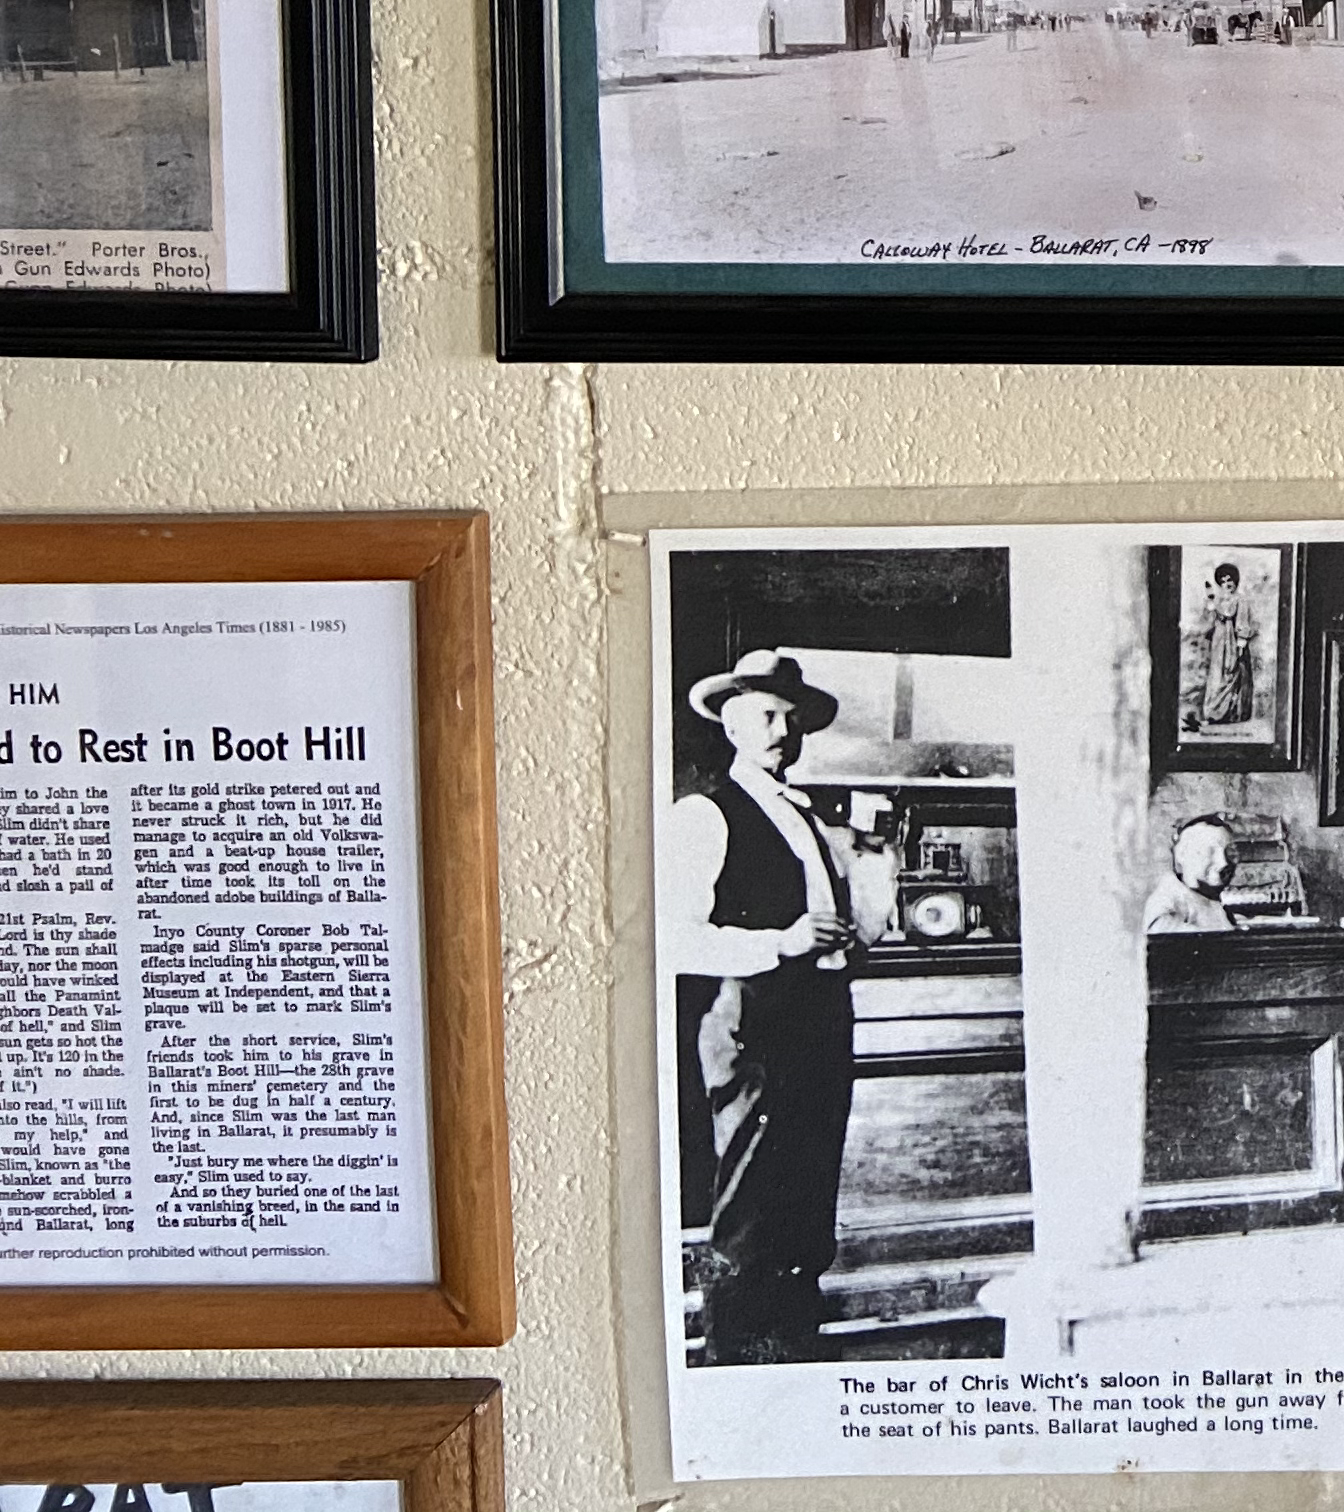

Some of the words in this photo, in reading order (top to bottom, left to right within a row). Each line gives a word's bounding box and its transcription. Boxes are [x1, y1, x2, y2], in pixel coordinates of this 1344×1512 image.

[91, 241, 145, 258] Porter
[14, 260, 51, 277] Gun
[64, 260, 141, 277] Edwards
[153, 261, 210, 279] Photo)
[53, 622, 131, 638] Newspapers
[133, 621, 158, 634] Los
[160, 620, 213, 637] Angeles
[214, 620, 256, 633] Times
[309, 619, 346, 634] 1985)
[8, 681, 60, 705] HIM
[29, 733, 62, 763] to
[77, 727, 149, 763] Rest
[162, 727, 194, 762] in
[211, 726, 289, 761] Boot
[304, 725, 365, 761] Hill
[130, 783, 163, 796] after
[168, 782, 186, 796] its
[190, 781, 220, 798] gold
[225, 782, 265, 795] strike
[269, 781, 322, 797] petered
[326, 782, 350, 795] out
[354, 782, 381, 795] and
[152, 924, 185, 939] Inyo
[195, 922, 245, 939] County
[255, 923, 311, 936] Coroner
[321, 922, 349, 936] Bob
[359, 922, 388, 936] Tal-
[59, 1018, 85, 1032] and
[90, 1018, 122, 1032] Slim
[38, 1246, 123, 1261] reproduction
[124, 1245, 195, 1261] prohibited
[197, 1244, 247, 1257] without
[250, 1244, 330, 1259] permission.
[838, 1377, 875, 1393] The
[886, 1377, 916, 1393] bar
[928, 1375, 947, 1392] of
[960, 1374, 1008, 1391] Chris
[1019, 1372, 1088, 1389] Wicht's
[1099, 1371, 1159, 1388] saloon
[1172, 1370, 1189, 1386] in
[1202, 1368, 1273, 1388] Ballarat
[1285, 1368, 1302, 1384] in
[1314, 1367, 1344, 1383] the
[840, 1404, 849, 1415] a
[859, 1401, 944, 1415] customer
[954, 1400, 974, 1416] to
[985, 1396, 1036, 1413] leave.
[1046, 1395, 1082, 1412] The
[1092, 1398, 1131, 1411] man
[1141, 1393, 1185, 1410] took
[1195, 1392, 1225, 1409] the
[1235, 1395, 1268, 1412] gun
[1278, 1394, 1325, 1410] away
[841, 1421, 870, 1437] the
[878, 1423, 914, 1438] seat
[921, 1420, 941, 1437] of
[948, 1417, 976, 1436] his
[984, 1421, 1039, 1438] pants.
[1048, 1417, 1118, 1434] Ballarat
[1127, 1415, 1197, 1436] laughed
[1205, 1419, 1215, 1431] a
[1224, 1415, 1263, 1435] long
[1271, 1413, 1317, 1430] time.
